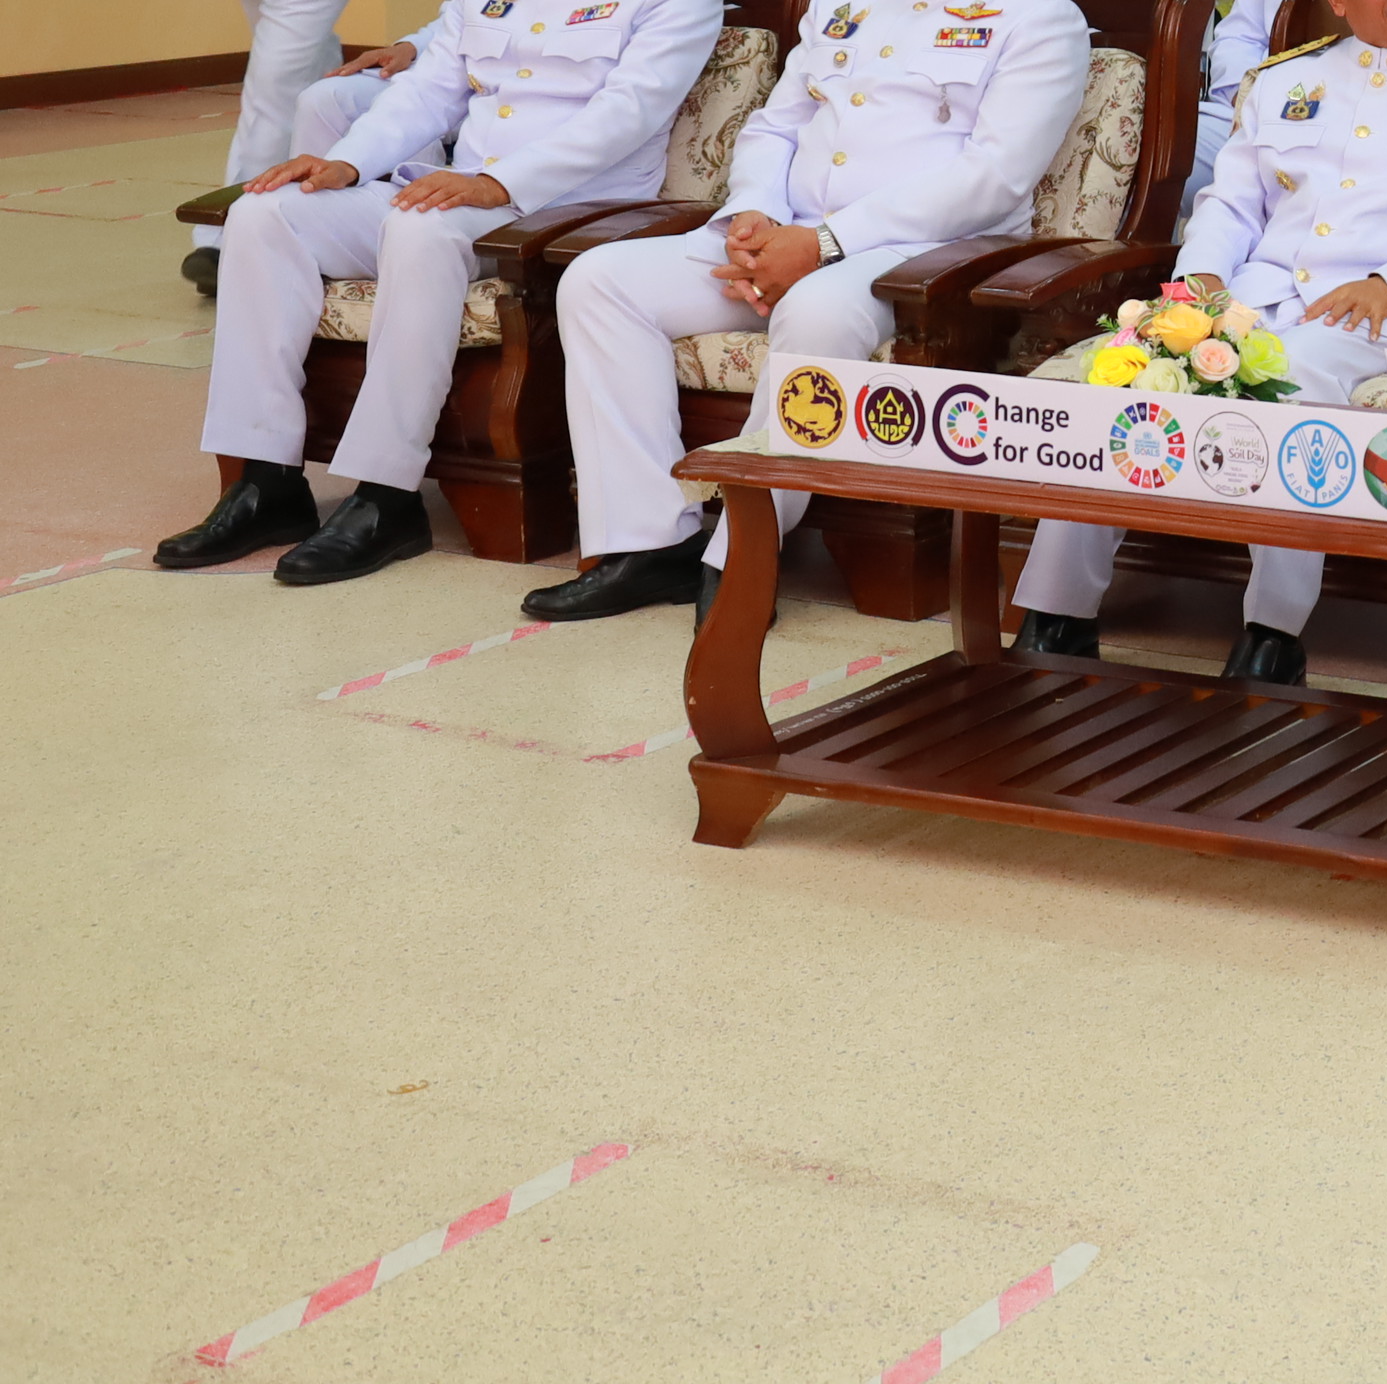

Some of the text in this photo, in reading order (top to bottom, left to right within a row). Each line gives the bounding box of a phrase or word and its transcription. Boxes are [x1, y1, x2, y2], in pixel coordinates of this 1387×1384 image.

[993, 437, 1104, 472] for Good
[1228, 447, 1265, 465] Soil Day
[1286, 473, 1349, 500] FIAT PANIS
